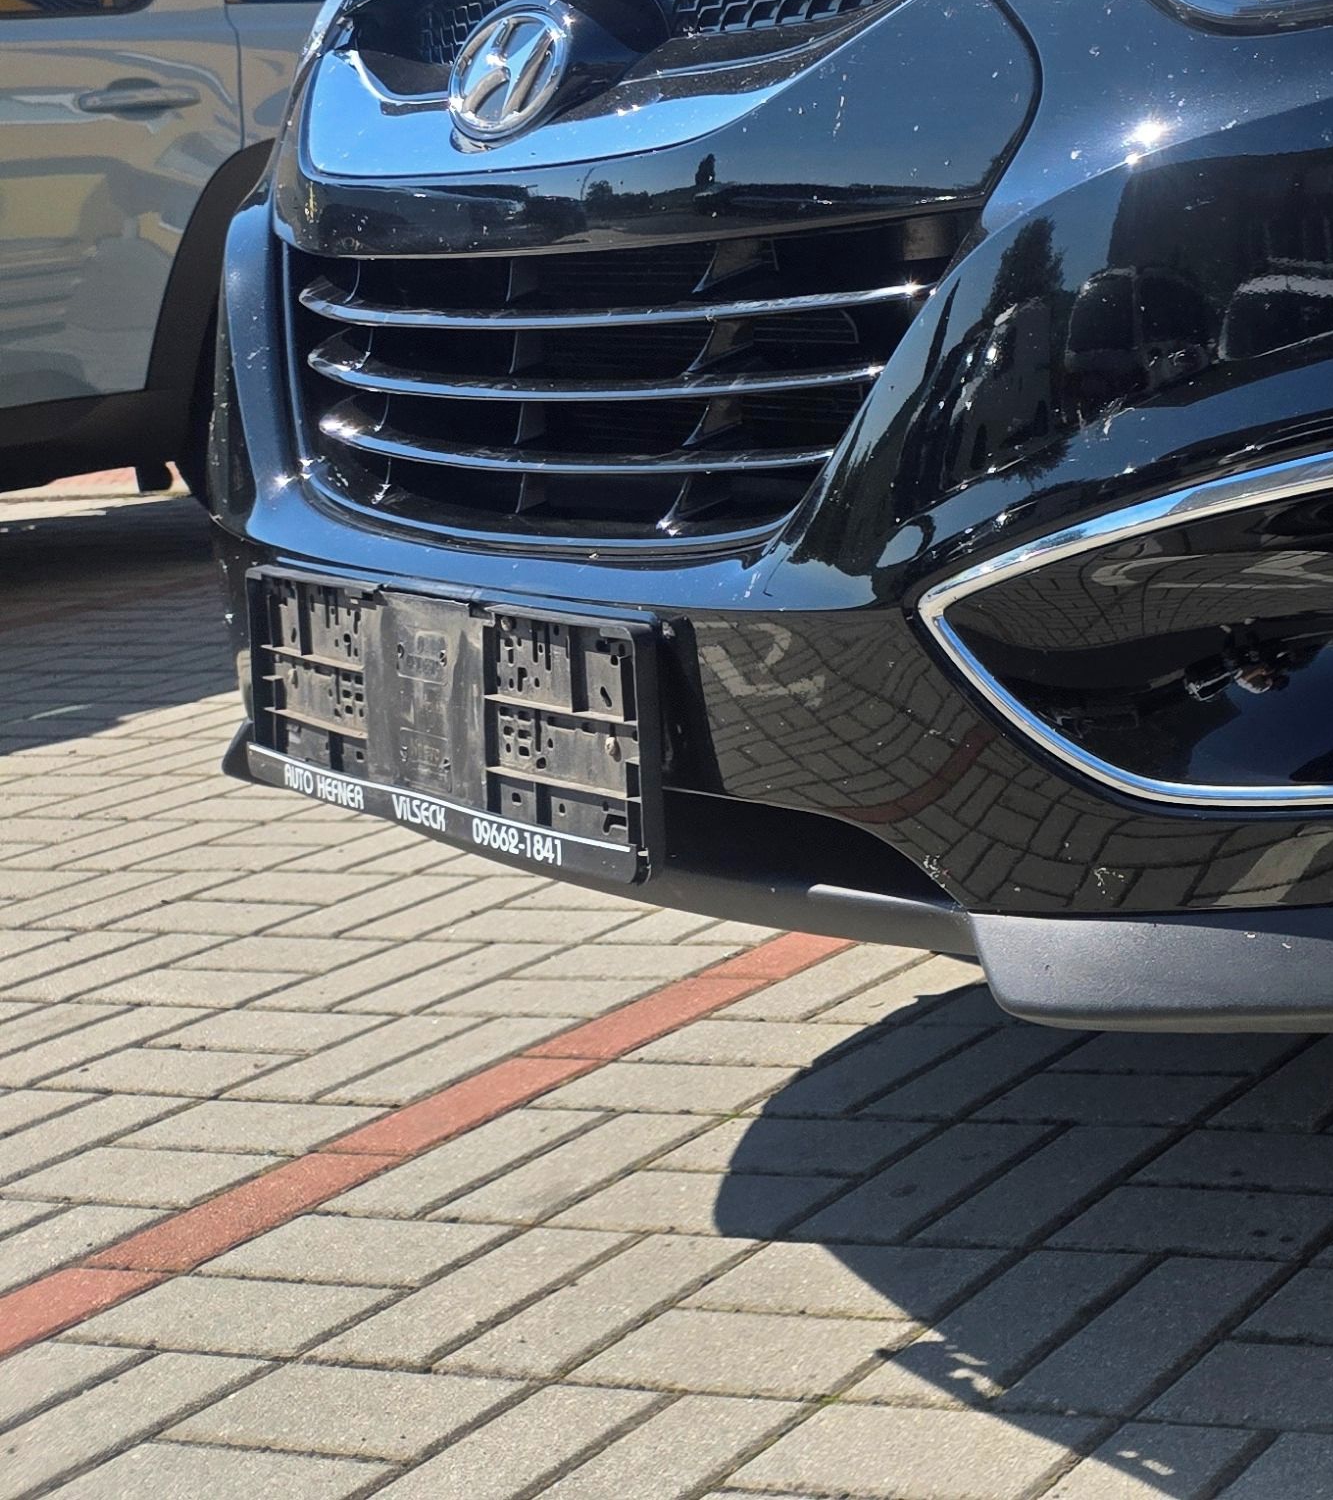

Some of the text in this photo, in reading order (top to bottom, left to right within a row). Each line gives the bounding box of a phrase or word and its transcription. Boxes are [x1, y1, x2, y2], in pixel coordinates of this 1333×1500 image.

[284, 763, 314, 794] AUTO
[317, 774, 365, 810] HEFNER
[472, 817, 562, 866] 09662-1841
